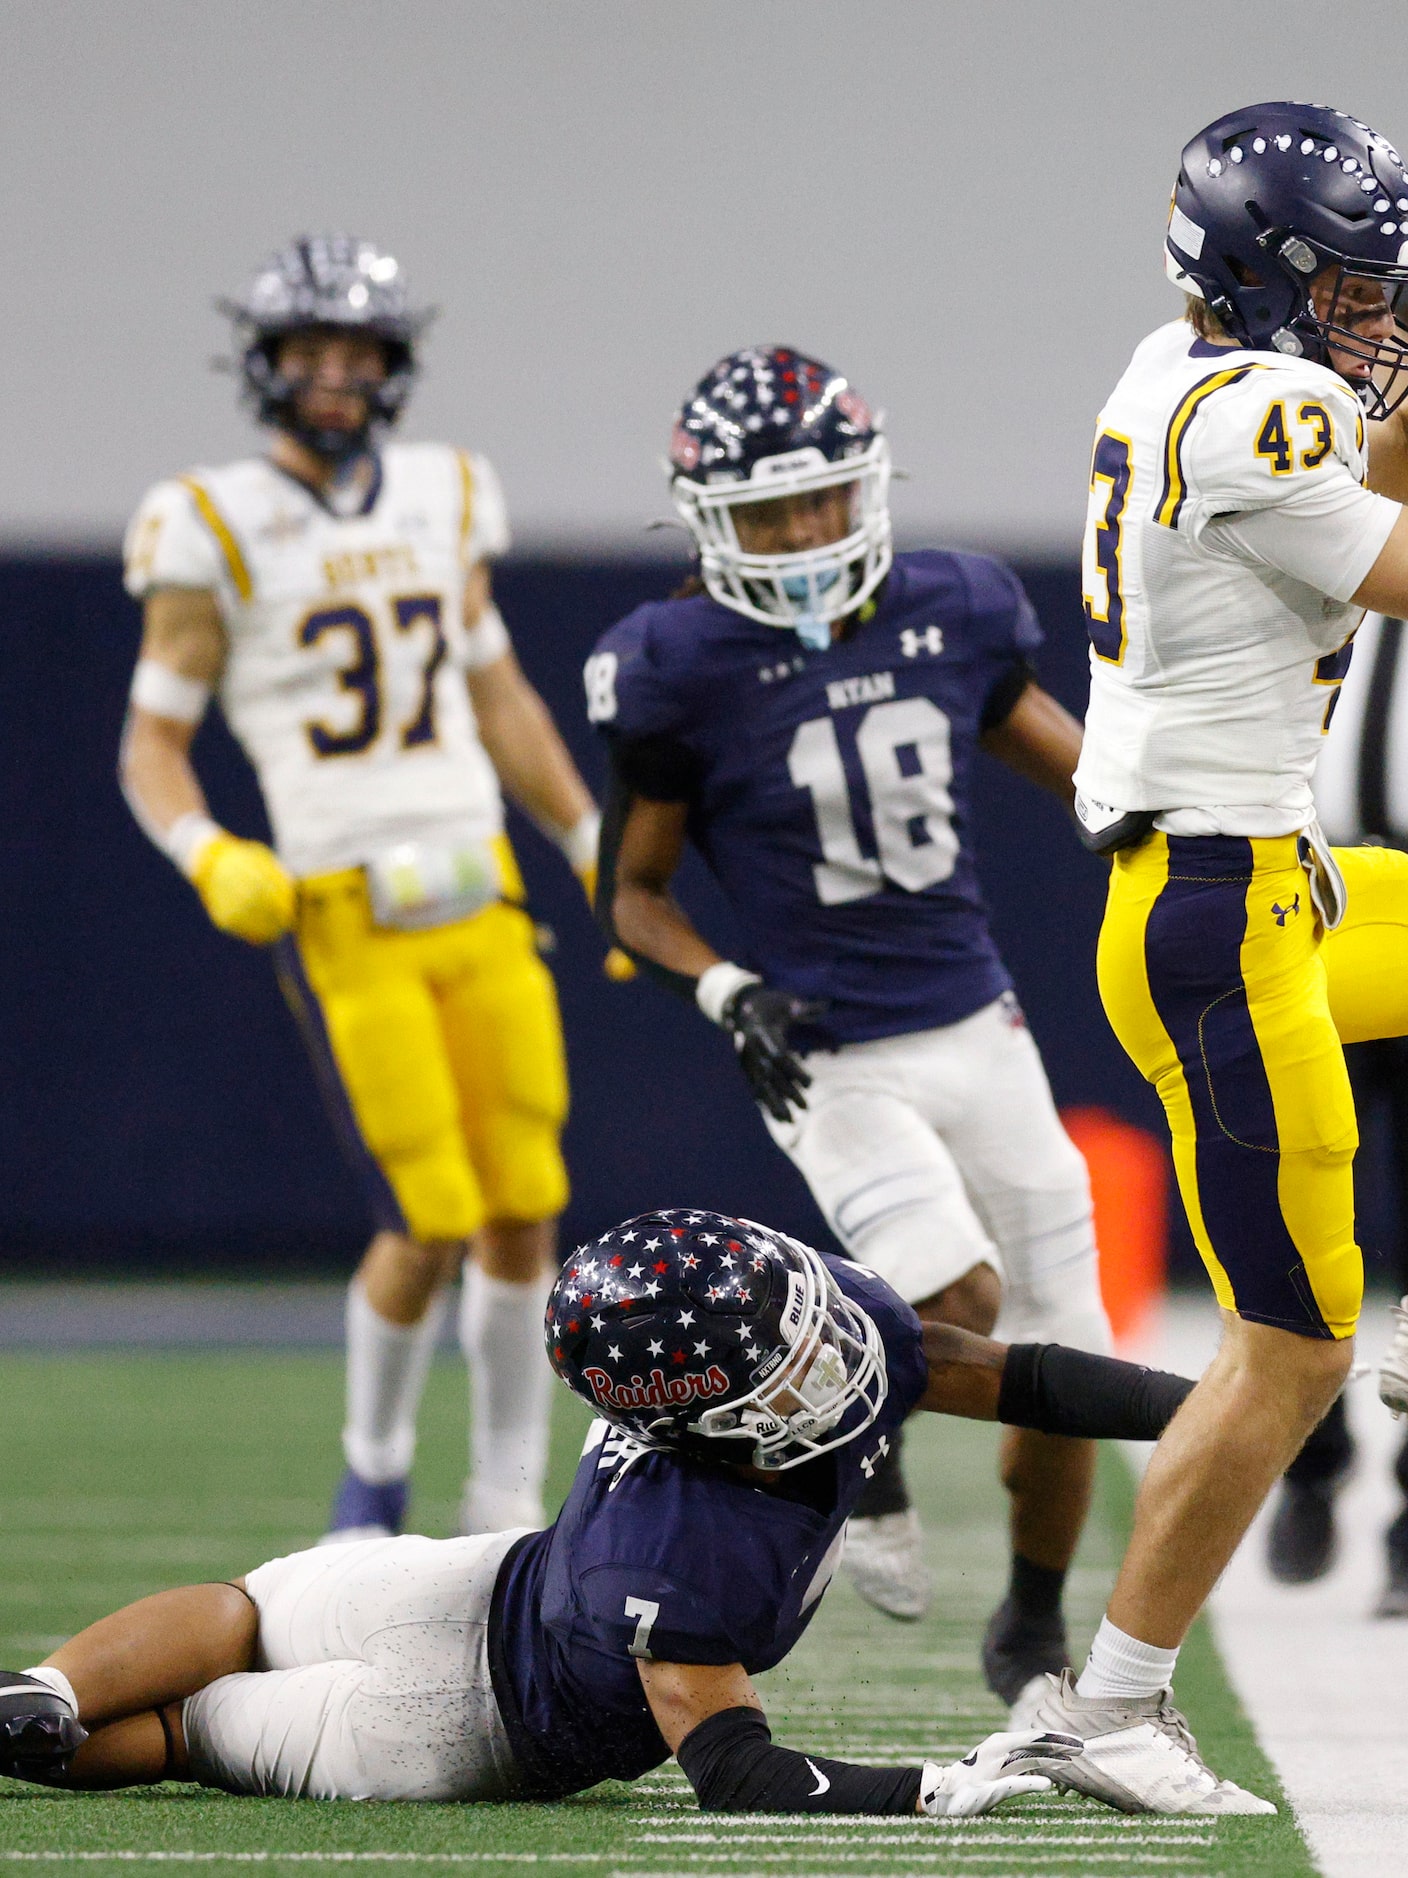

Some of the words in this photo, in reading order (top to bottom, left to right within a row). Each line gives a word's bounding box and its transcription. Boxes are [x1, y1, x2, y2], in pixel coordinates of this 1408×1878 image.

[1253, 400, 1335, 477] 43
[297, 592, 448, 760] 37
[787, 697, 960, 906] 18
[789, 1284, 805, 1326] BLUE
[582, 1365, 730, 1409] Raiders
[624, 1596, 660, 1658] 7
